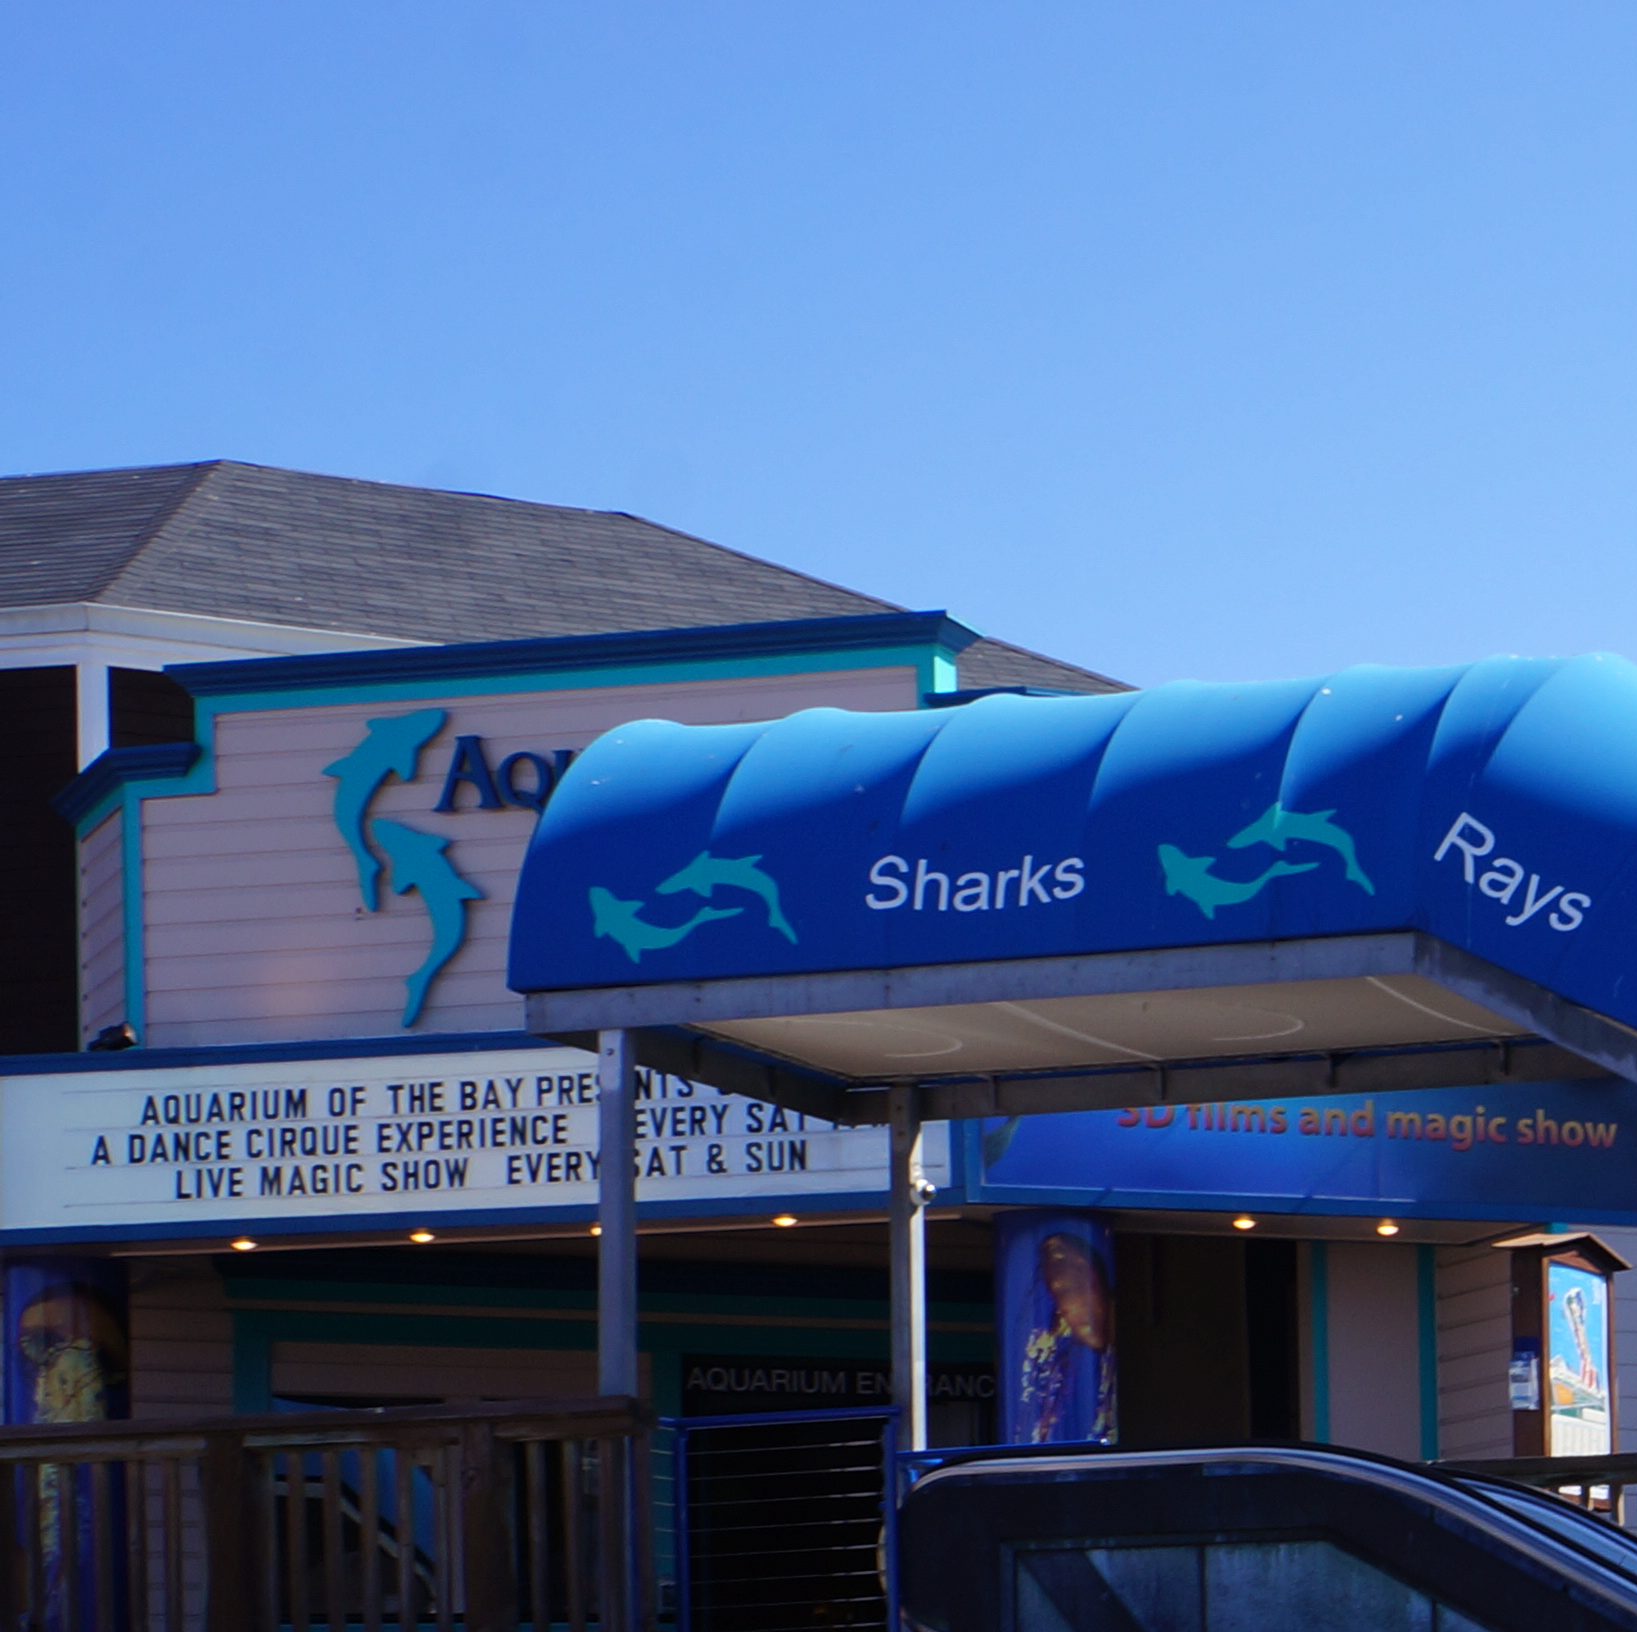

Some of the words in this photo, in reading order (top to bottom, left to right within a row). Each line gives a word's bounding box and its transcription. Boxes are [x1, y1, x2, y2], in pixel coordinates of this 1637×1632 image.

[865, 853, 1086, 912] Sharks
[1434, 811, 1591, 931] Rays
[141, 1088, 308, 1126] AQUARIUM
[328, 1086, 366, 1117] OF
[387, 1081, 445, 1114] THE
[460, 1077, 523, 1110] BAY
[1186, 1101, 1288, 1134] films
[1299, 1099, 1375, 1138] and
[1386, 1106, 1506, 1152] magic
[1516, 1109, 1618, 1148] show
[91, 1135, 112, 1165] A
[129, 1130, 232, 1164] DANCE
[246, 1124, 360, 1159] CIRQUE
[377, 1112, 568, 1152] EXPERIENCE
[175, 1166, 244, 1200] LIVE
[260, 1162, 366, 1197] MAGIC
[381, 1156, 471, 1192] SHOW
[507, 1151, 599, 1185] EVERY
[706, 1142, 728, 1174] &
[746, 1139, 807, 1172] SUN
[687, 1367, 847, 1395] AQUARIUM
